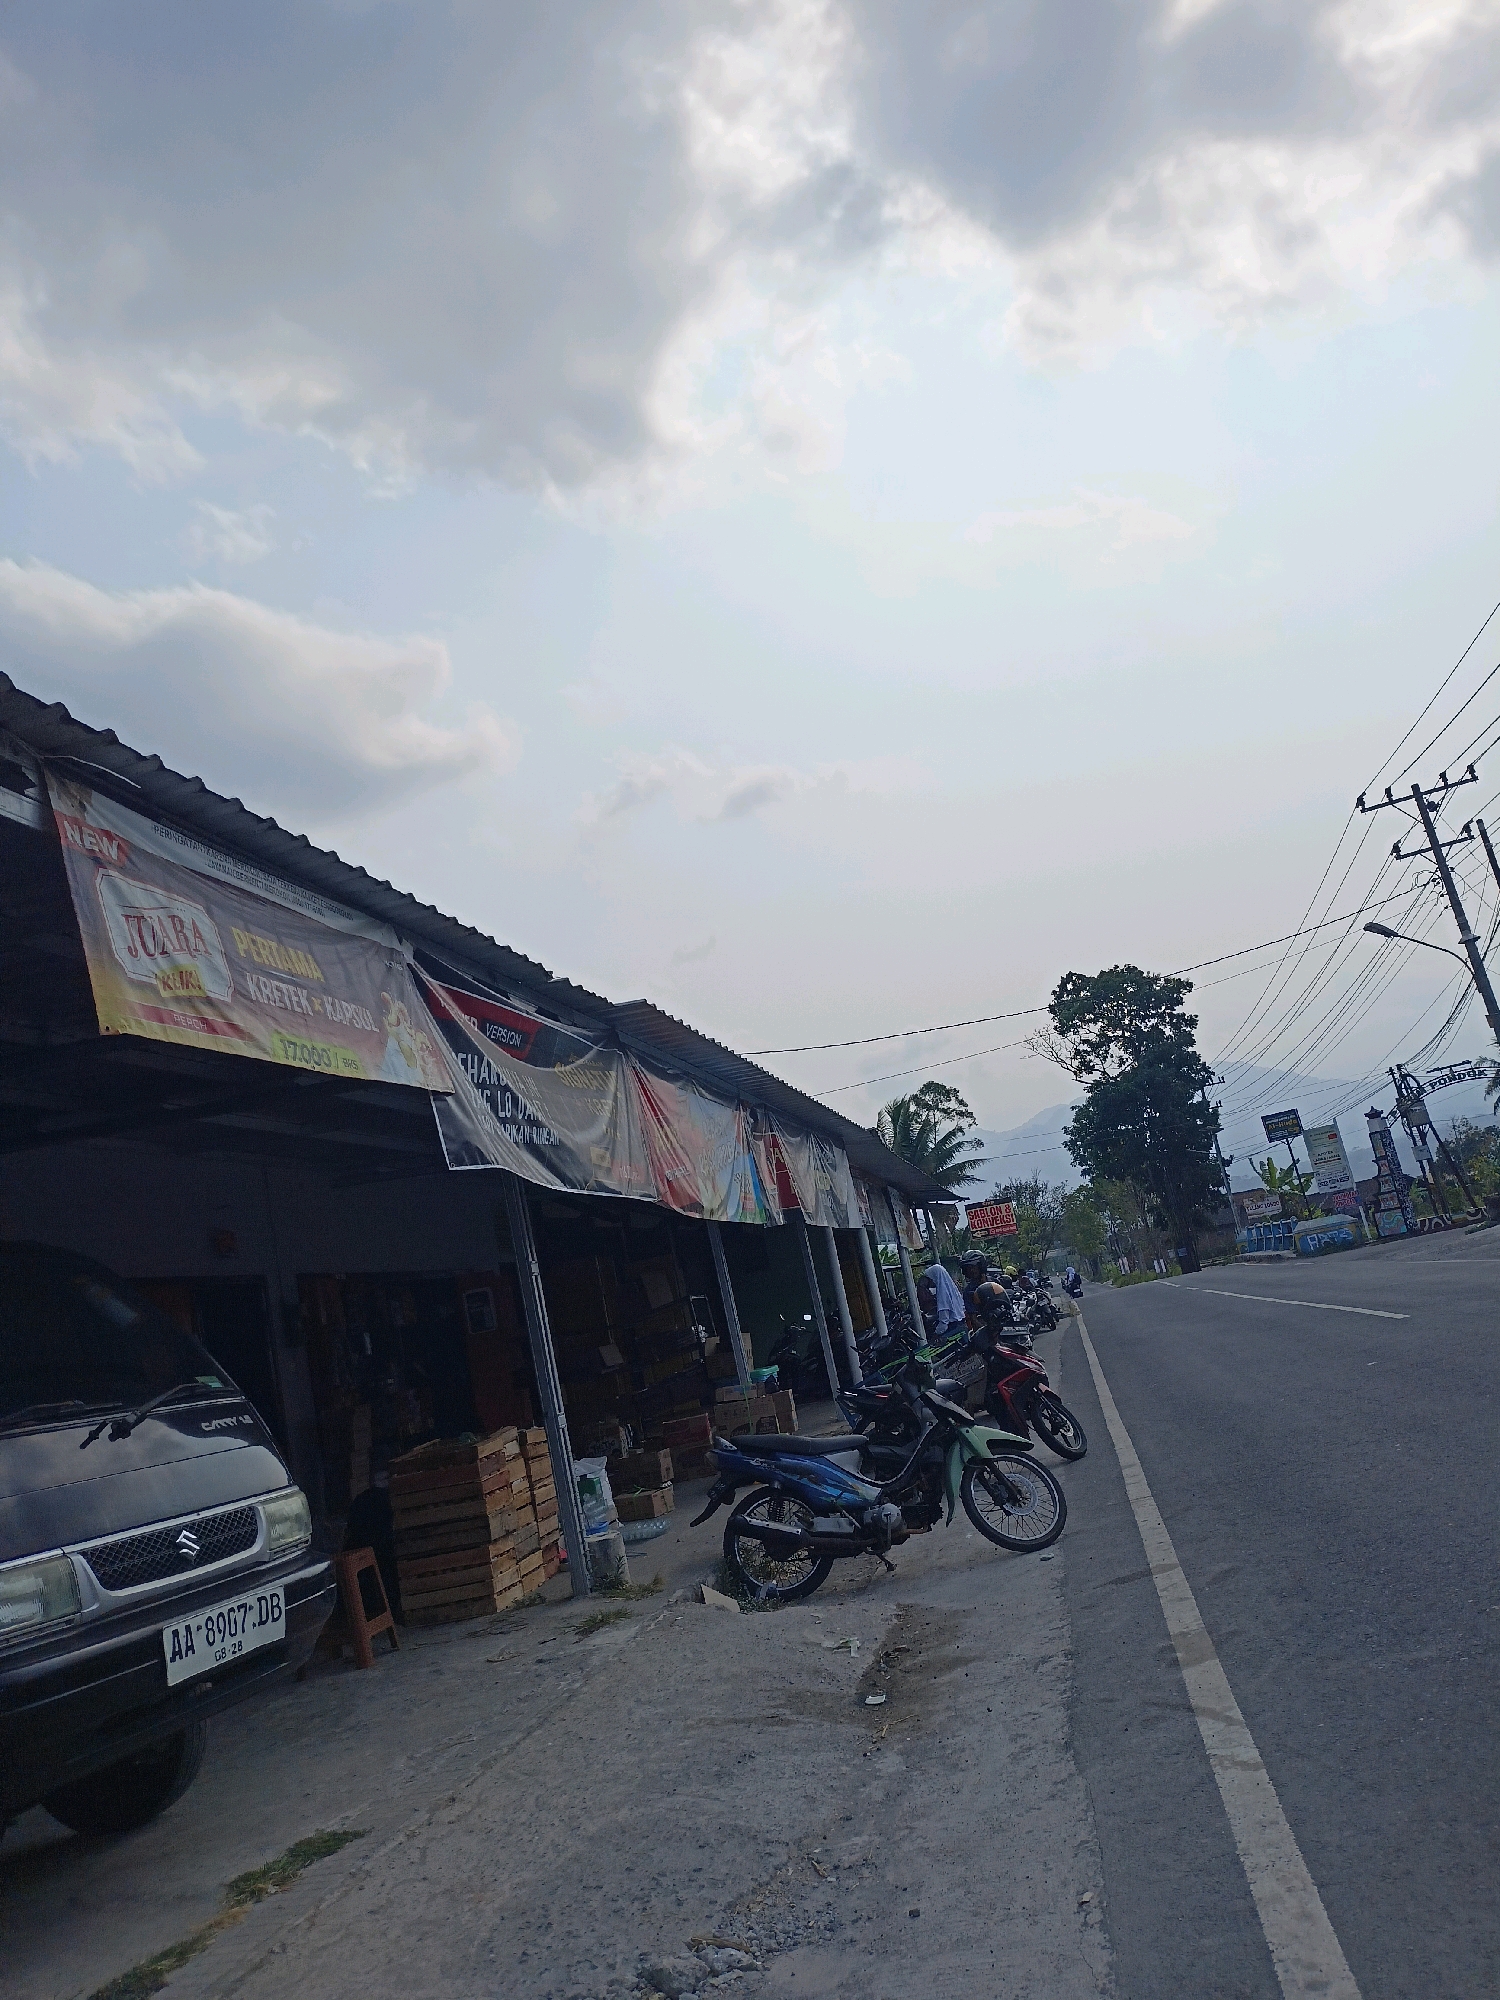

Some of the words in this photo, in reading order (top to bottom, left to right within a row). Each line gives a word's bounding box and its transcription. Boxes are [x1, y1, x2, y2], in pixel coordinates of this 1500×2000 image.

[64, 821, 119, 861] NEW
[121, 914, 211, 960] JUARA
[231, 926, 325, 983] PERTAMA
[246, 972, 314, 1016] KRETEK
[323, 996, 380, 1033] KAPSUL
[485, 1022, 522, 1048] VERSION
[280, 1038, 332, 1068] 17.000
[1430, 1069, 1488, 1090] PONDOK
[497, 1090, 513, 1118] LO
[968, 1205, 1002, 1220] SABLON
[1004, 1203, 1012, 1214] &
[970, 1213, 1015, 1231] KONVEKSI
[169, 1623, 196, 1664] AA
[204, 1602, 248, 1648] 8907
[256, 1592, 283, 1627] DB
